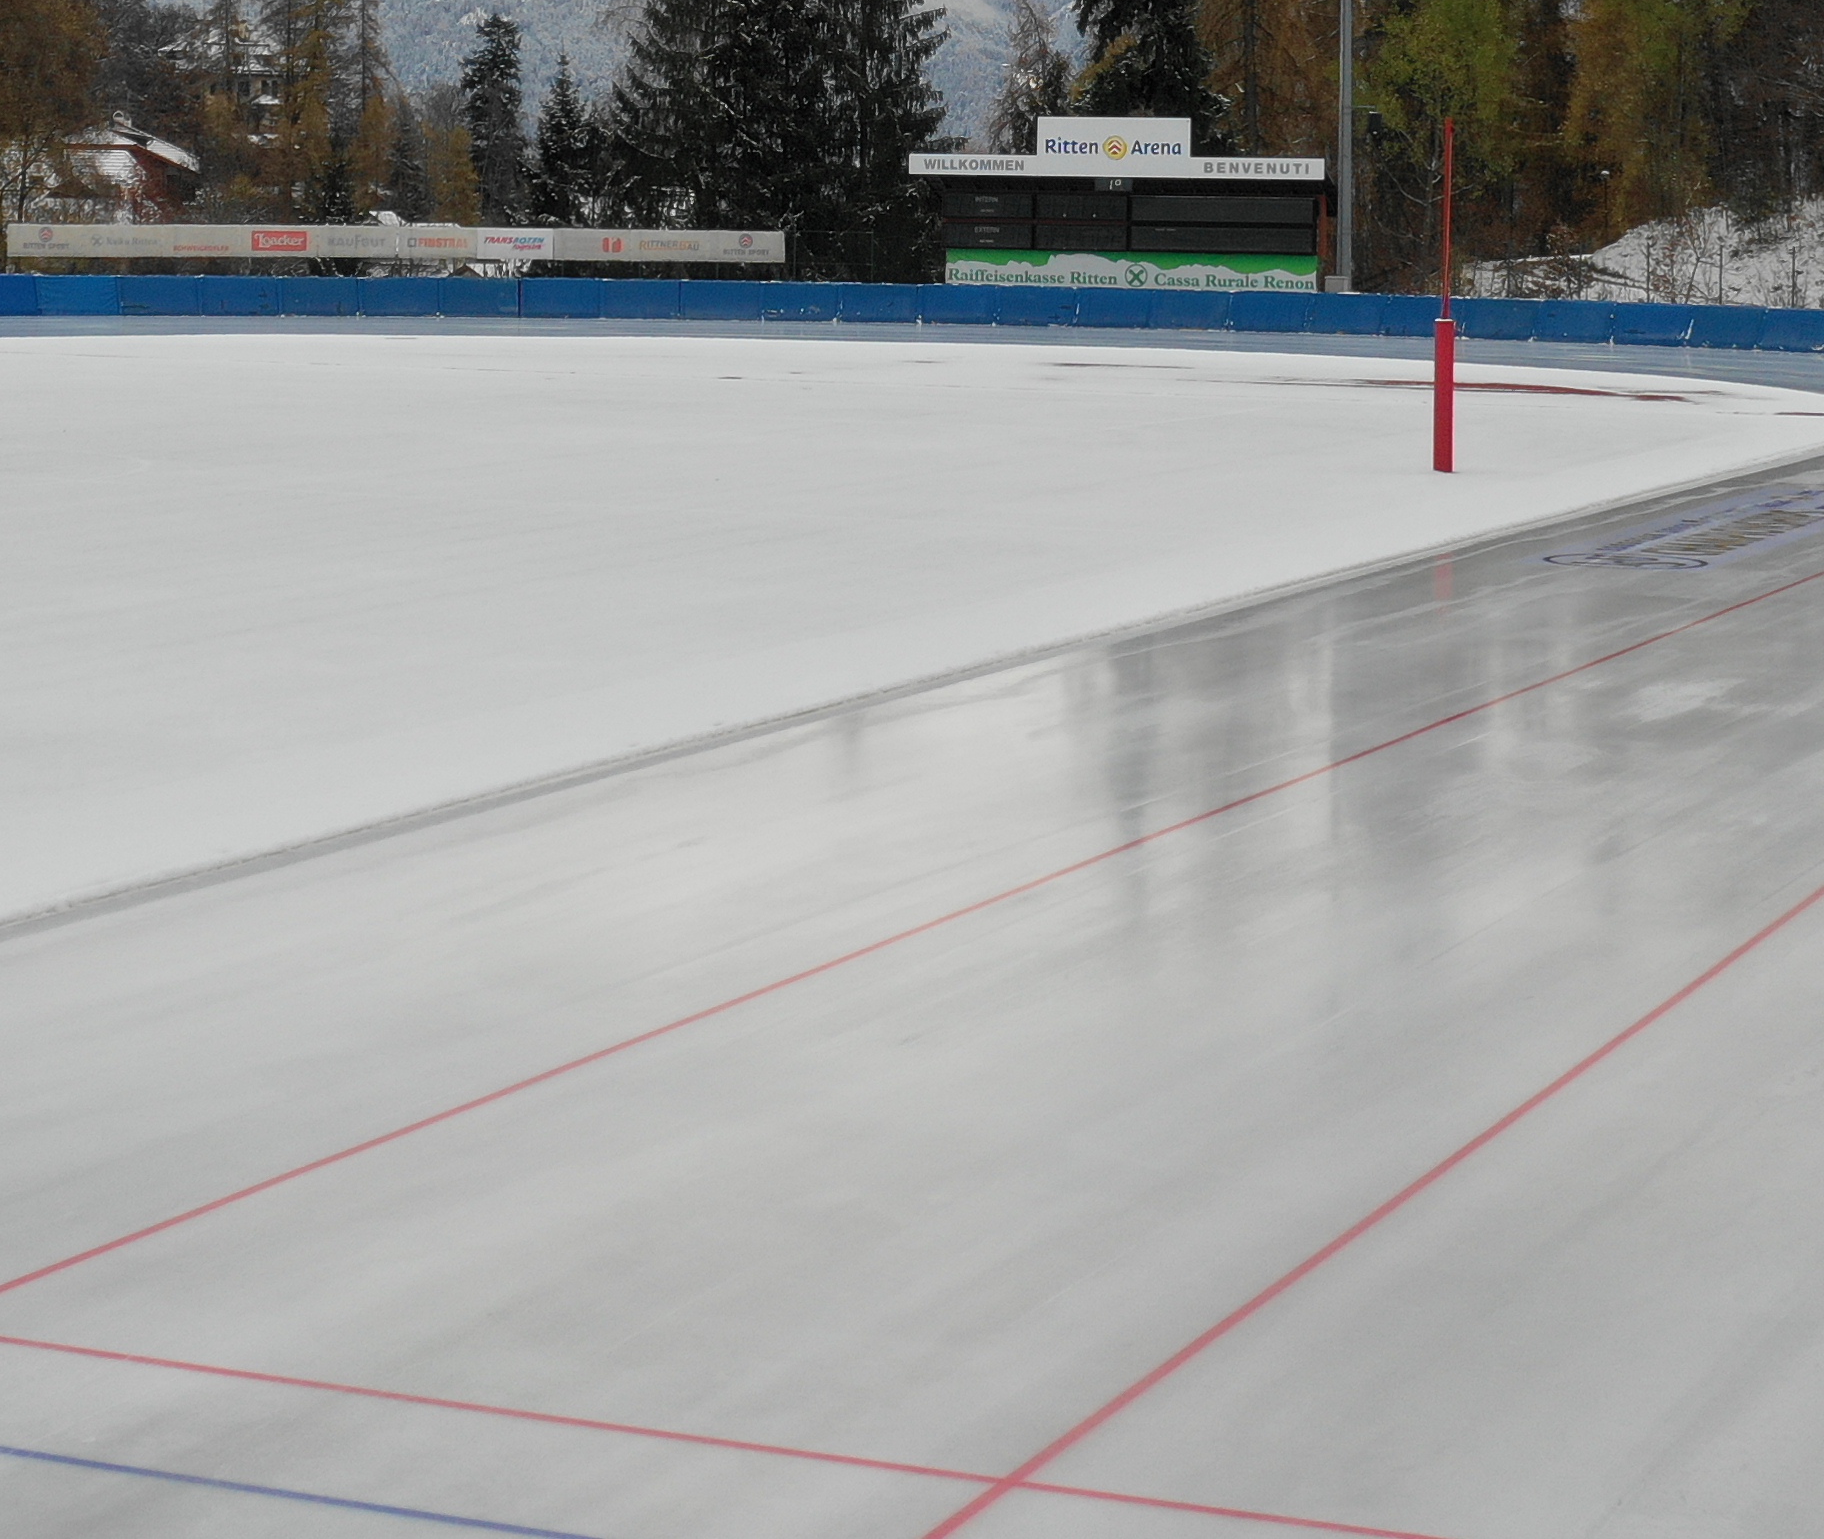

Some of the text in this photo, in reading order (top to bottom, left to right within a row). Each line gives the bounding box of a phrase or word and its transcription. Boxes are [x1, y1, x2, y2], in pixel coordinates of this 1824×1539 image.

[1044, 138, 1182, 156] Ritten Arena
[923, 158, 1025, 172] WILLKOMMEN
[1203, 161, 1311, 176] BENVENUTI
[254, 232, 305, 249] Loacker
[947, 267, 1316, 291] Raiffeisenkasse Ritten Cassa Rurale Renon
